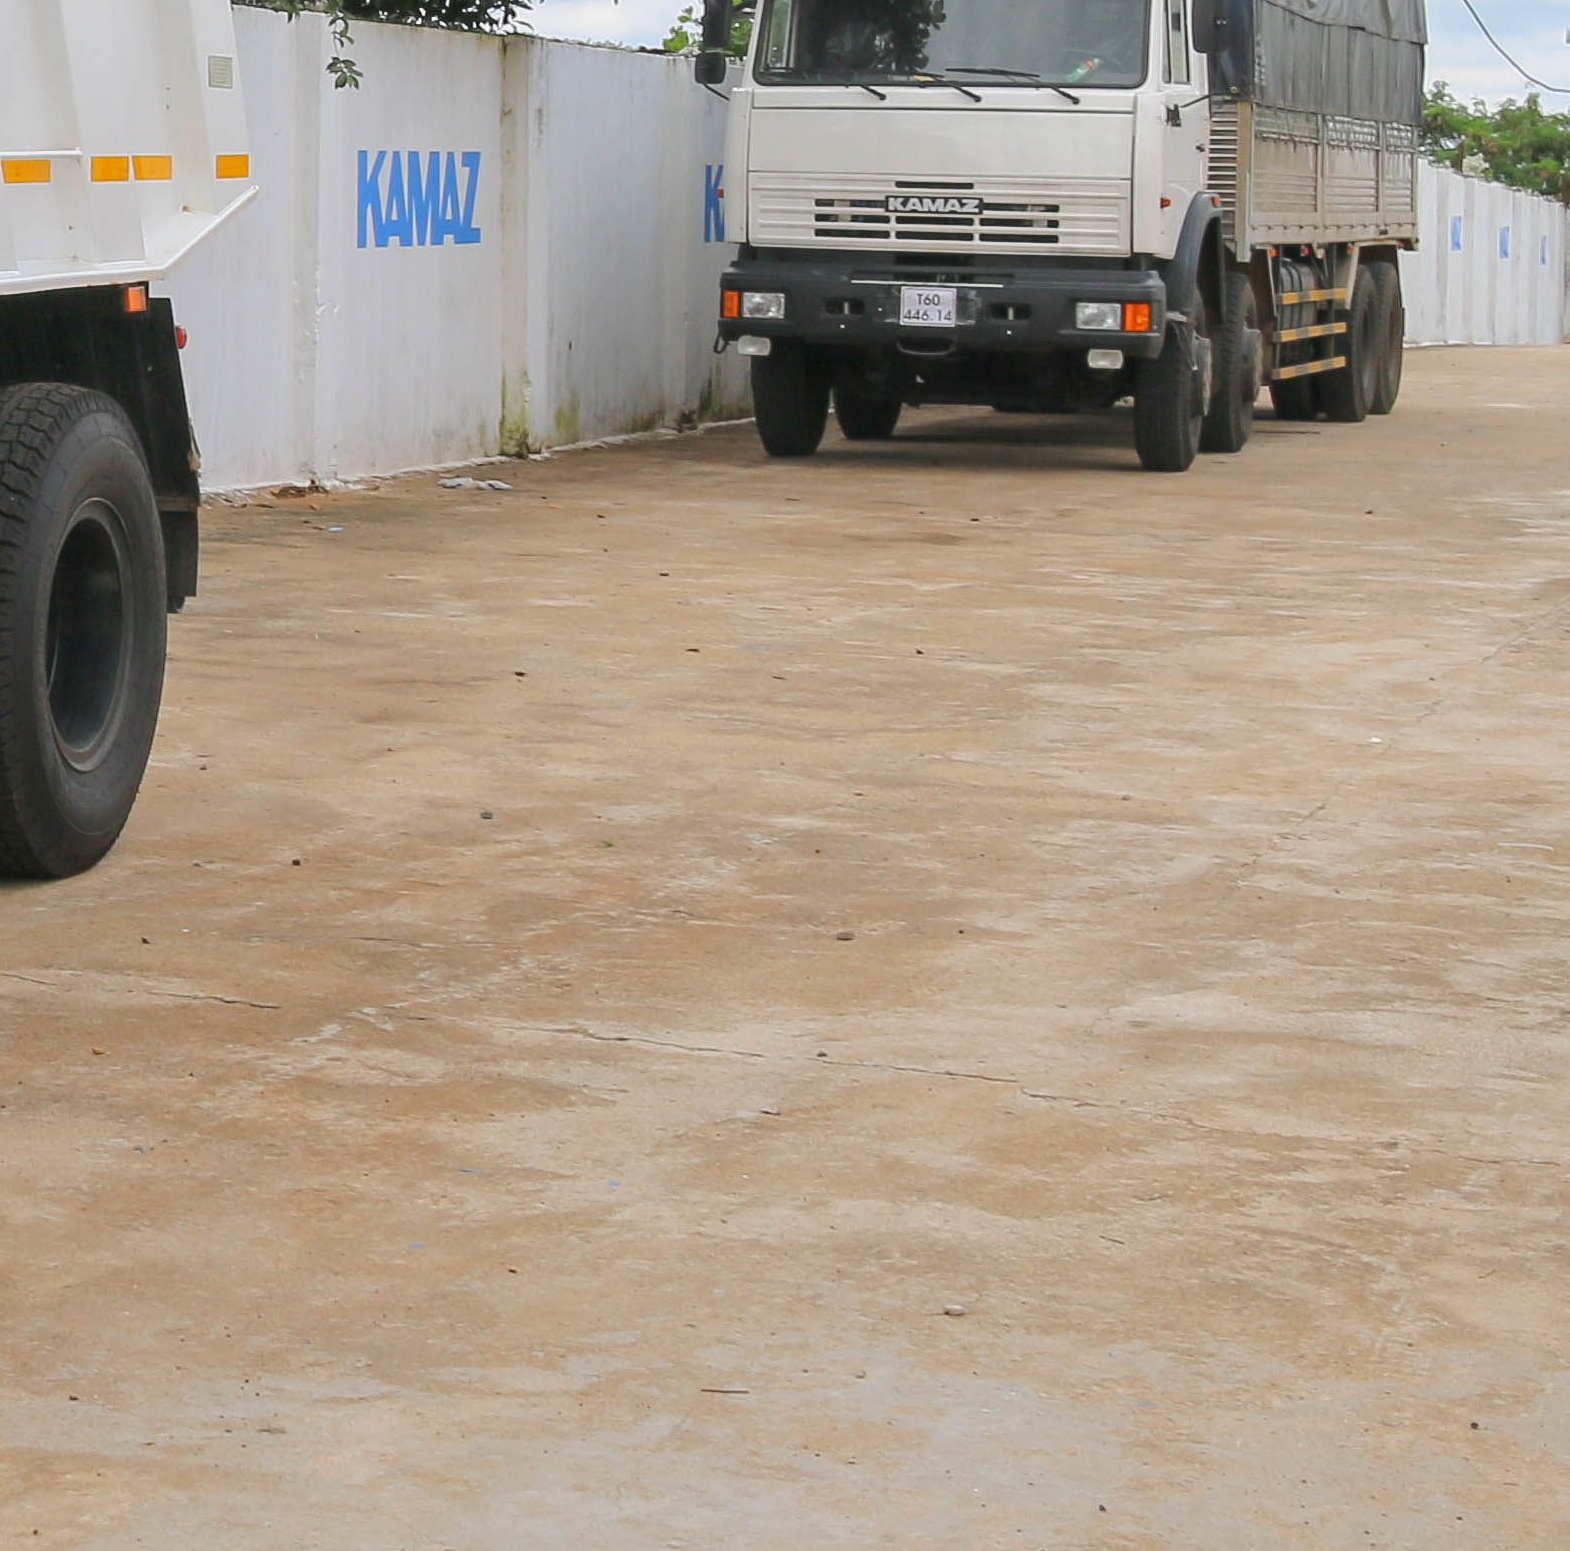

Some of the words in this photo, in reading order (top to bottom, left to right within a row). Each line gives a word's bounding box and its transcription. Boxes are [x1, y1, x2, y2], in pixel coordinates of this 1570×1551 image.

[357, 150, 481, 249] KAMAZ
[887, 197, 980, 213] KAMAZ
[916, 293, 941, 306] T60
